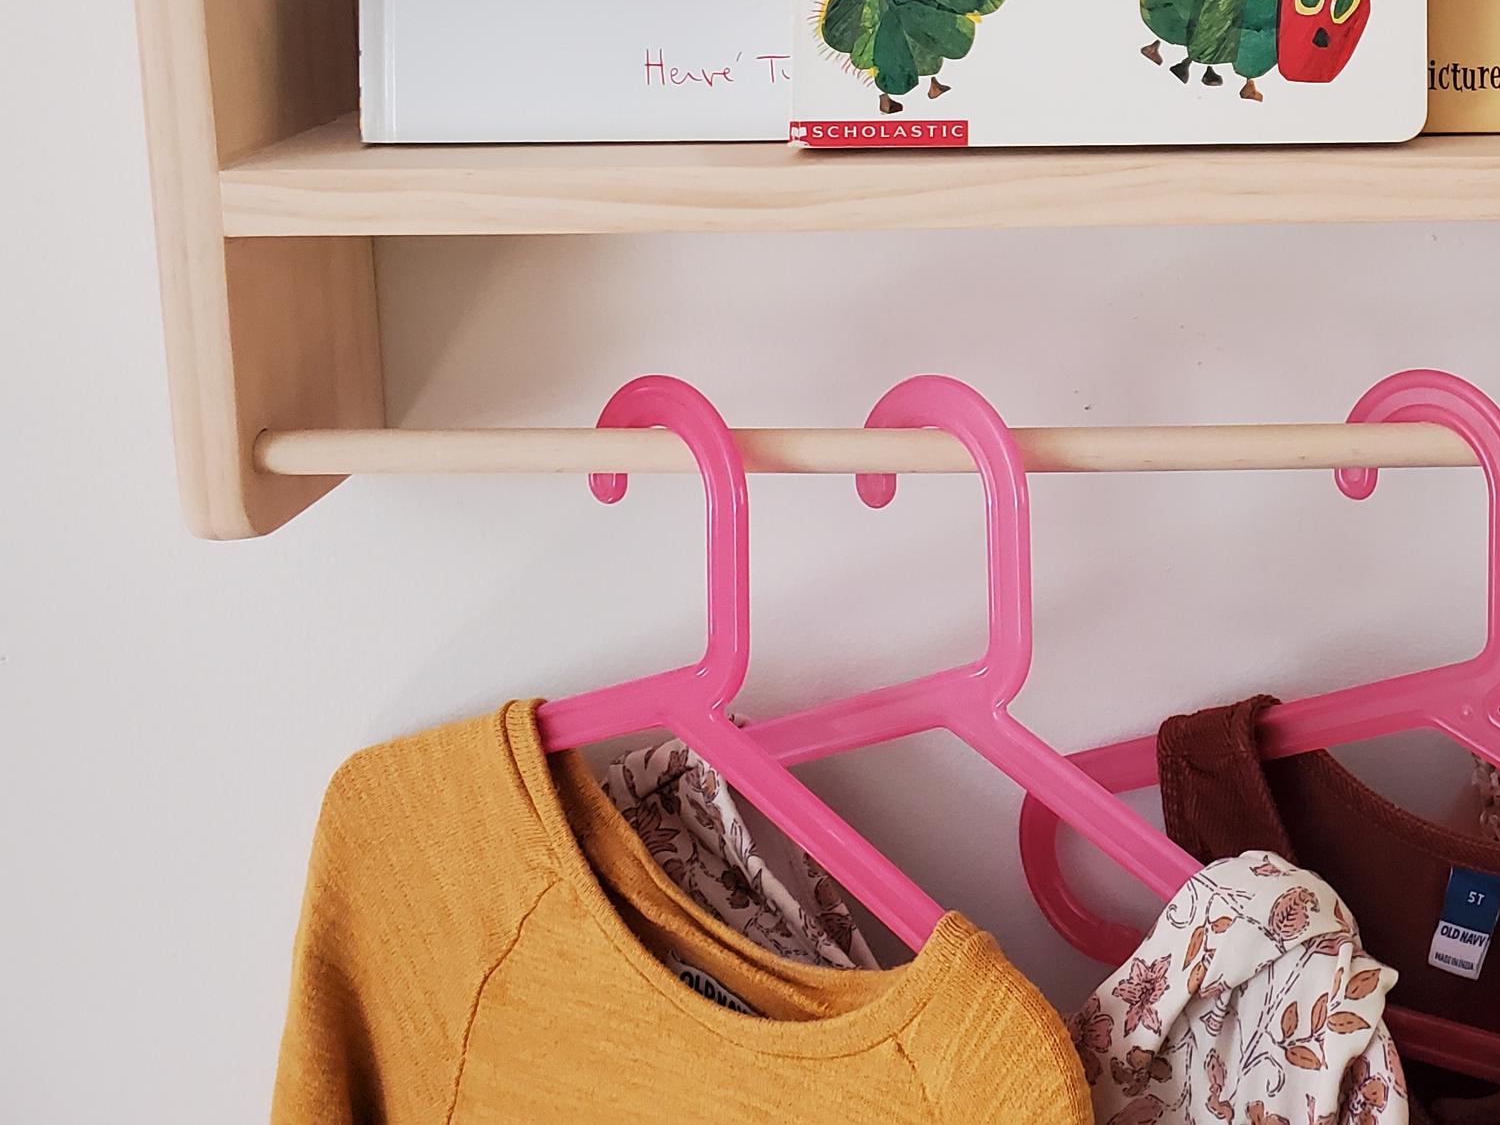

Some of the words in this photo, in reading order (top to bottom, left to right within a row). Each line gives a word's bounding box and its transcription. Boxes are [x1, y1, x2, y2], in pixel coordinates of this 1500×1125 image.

[812, 125, 964, 139] SCHOLASTIC
[1467, 891, 1485, 906] 5T
[1440, 925, 1460, 940] OLD
[1459, 931, 1486, 947] NAVY
